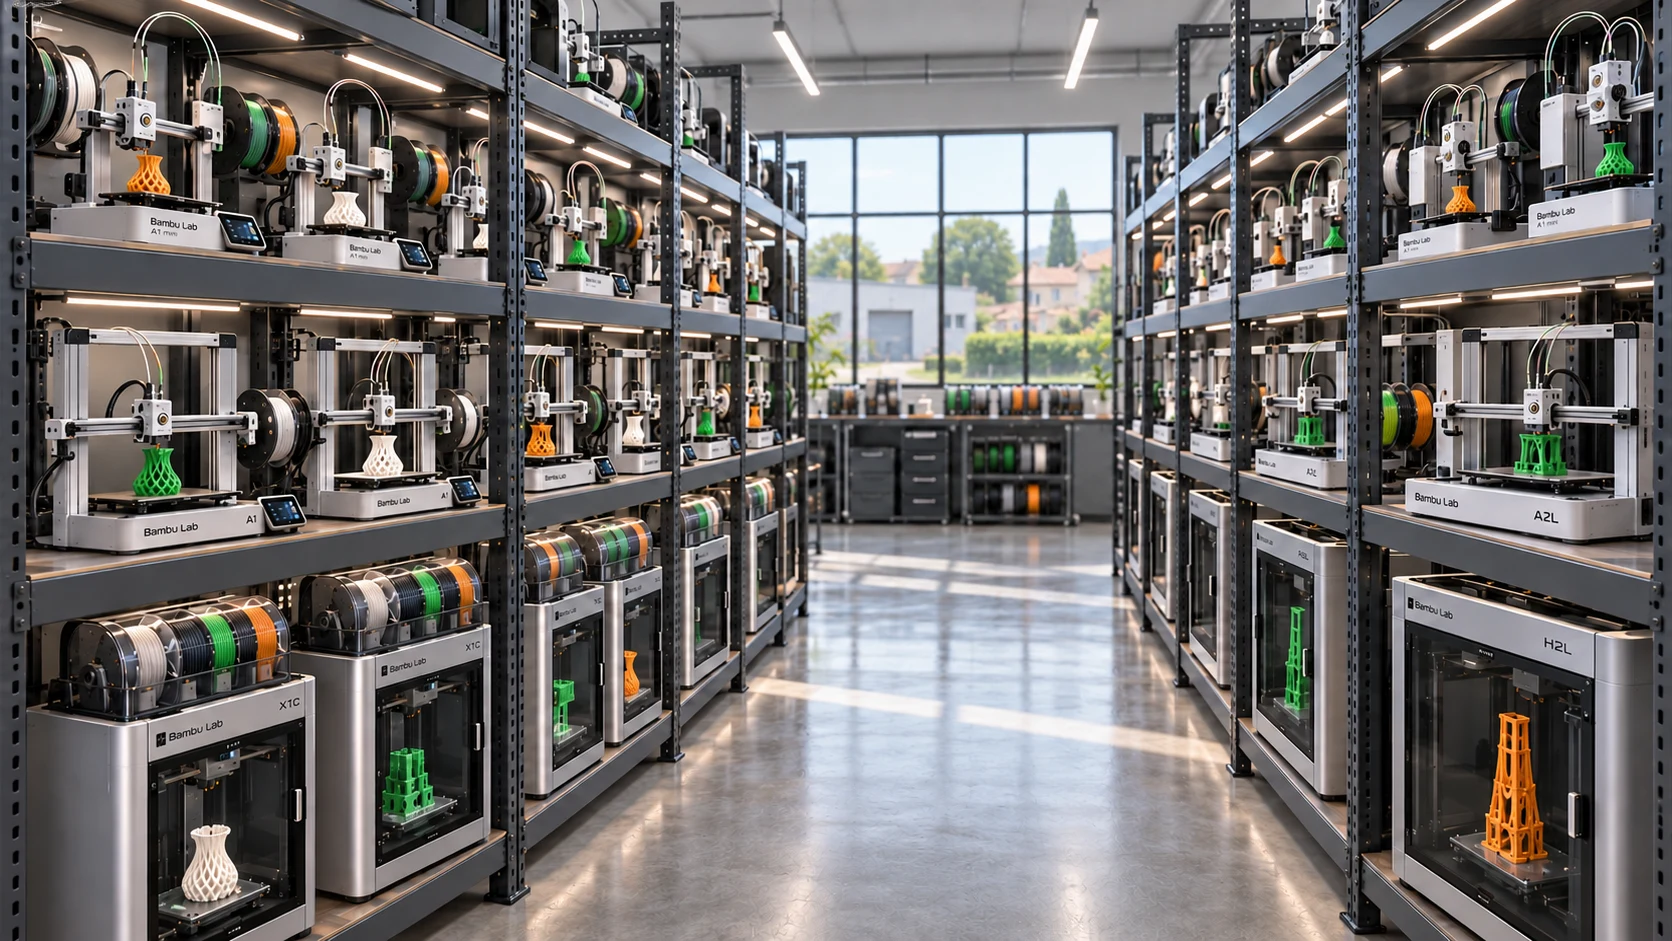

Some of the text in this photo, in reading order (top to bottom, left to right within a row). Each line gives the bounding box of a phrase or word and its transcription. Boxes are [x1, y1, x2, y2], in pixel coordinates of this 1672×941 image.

[1536, 207, 1575, 220] Bambu Lab
[150, 217, 198, 231] Bambu Lab
[377, 497, 411, 508] Bambu Lab
[1414, 492, 1459, 508] Bambu Lab
[246, 515, 257, 524] A1
[1533, 510, 1559, 524] A2L
[144, 522, 199, 537] Bambu Lab
[1414, 600, 1453, 620] Bambu Lab
[465, 641, 481, 652] X1C
[1543, 637, 1572, 656] H2L
[389, 658, 427, 673] Bambu Lab
[279, 697, 300, 710] X1C
[168, 719, 223, 742] Bambu Lab
